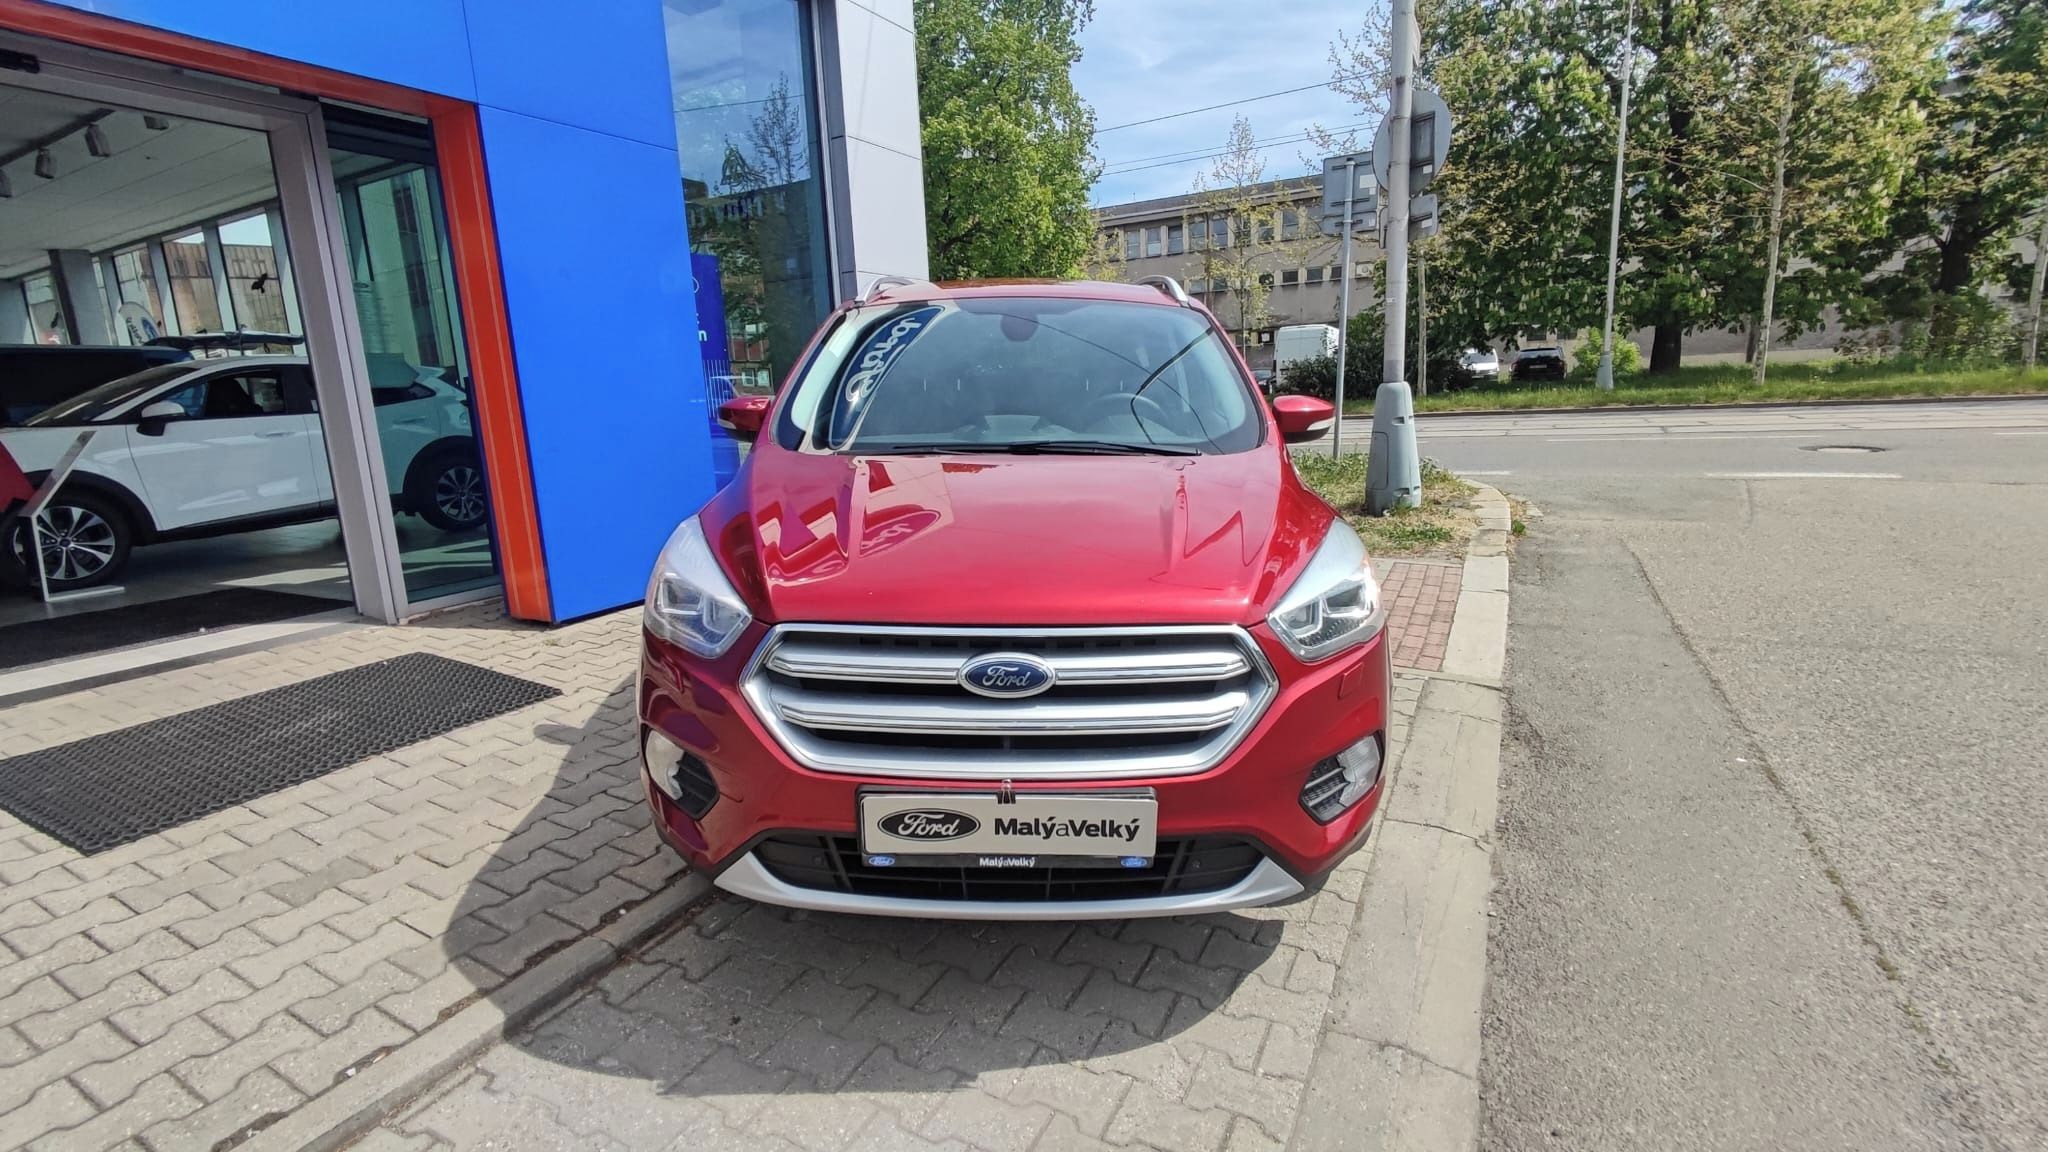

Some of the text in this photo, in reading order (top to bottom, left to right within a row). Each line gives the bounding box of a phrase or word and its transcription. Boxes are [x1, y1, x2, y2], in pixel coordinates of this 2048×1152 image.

[982, 665, 1031, 687] Ford
[897, 812, 961, 837] Ford
[994, 817, 1141, 842] MalýaVelký
